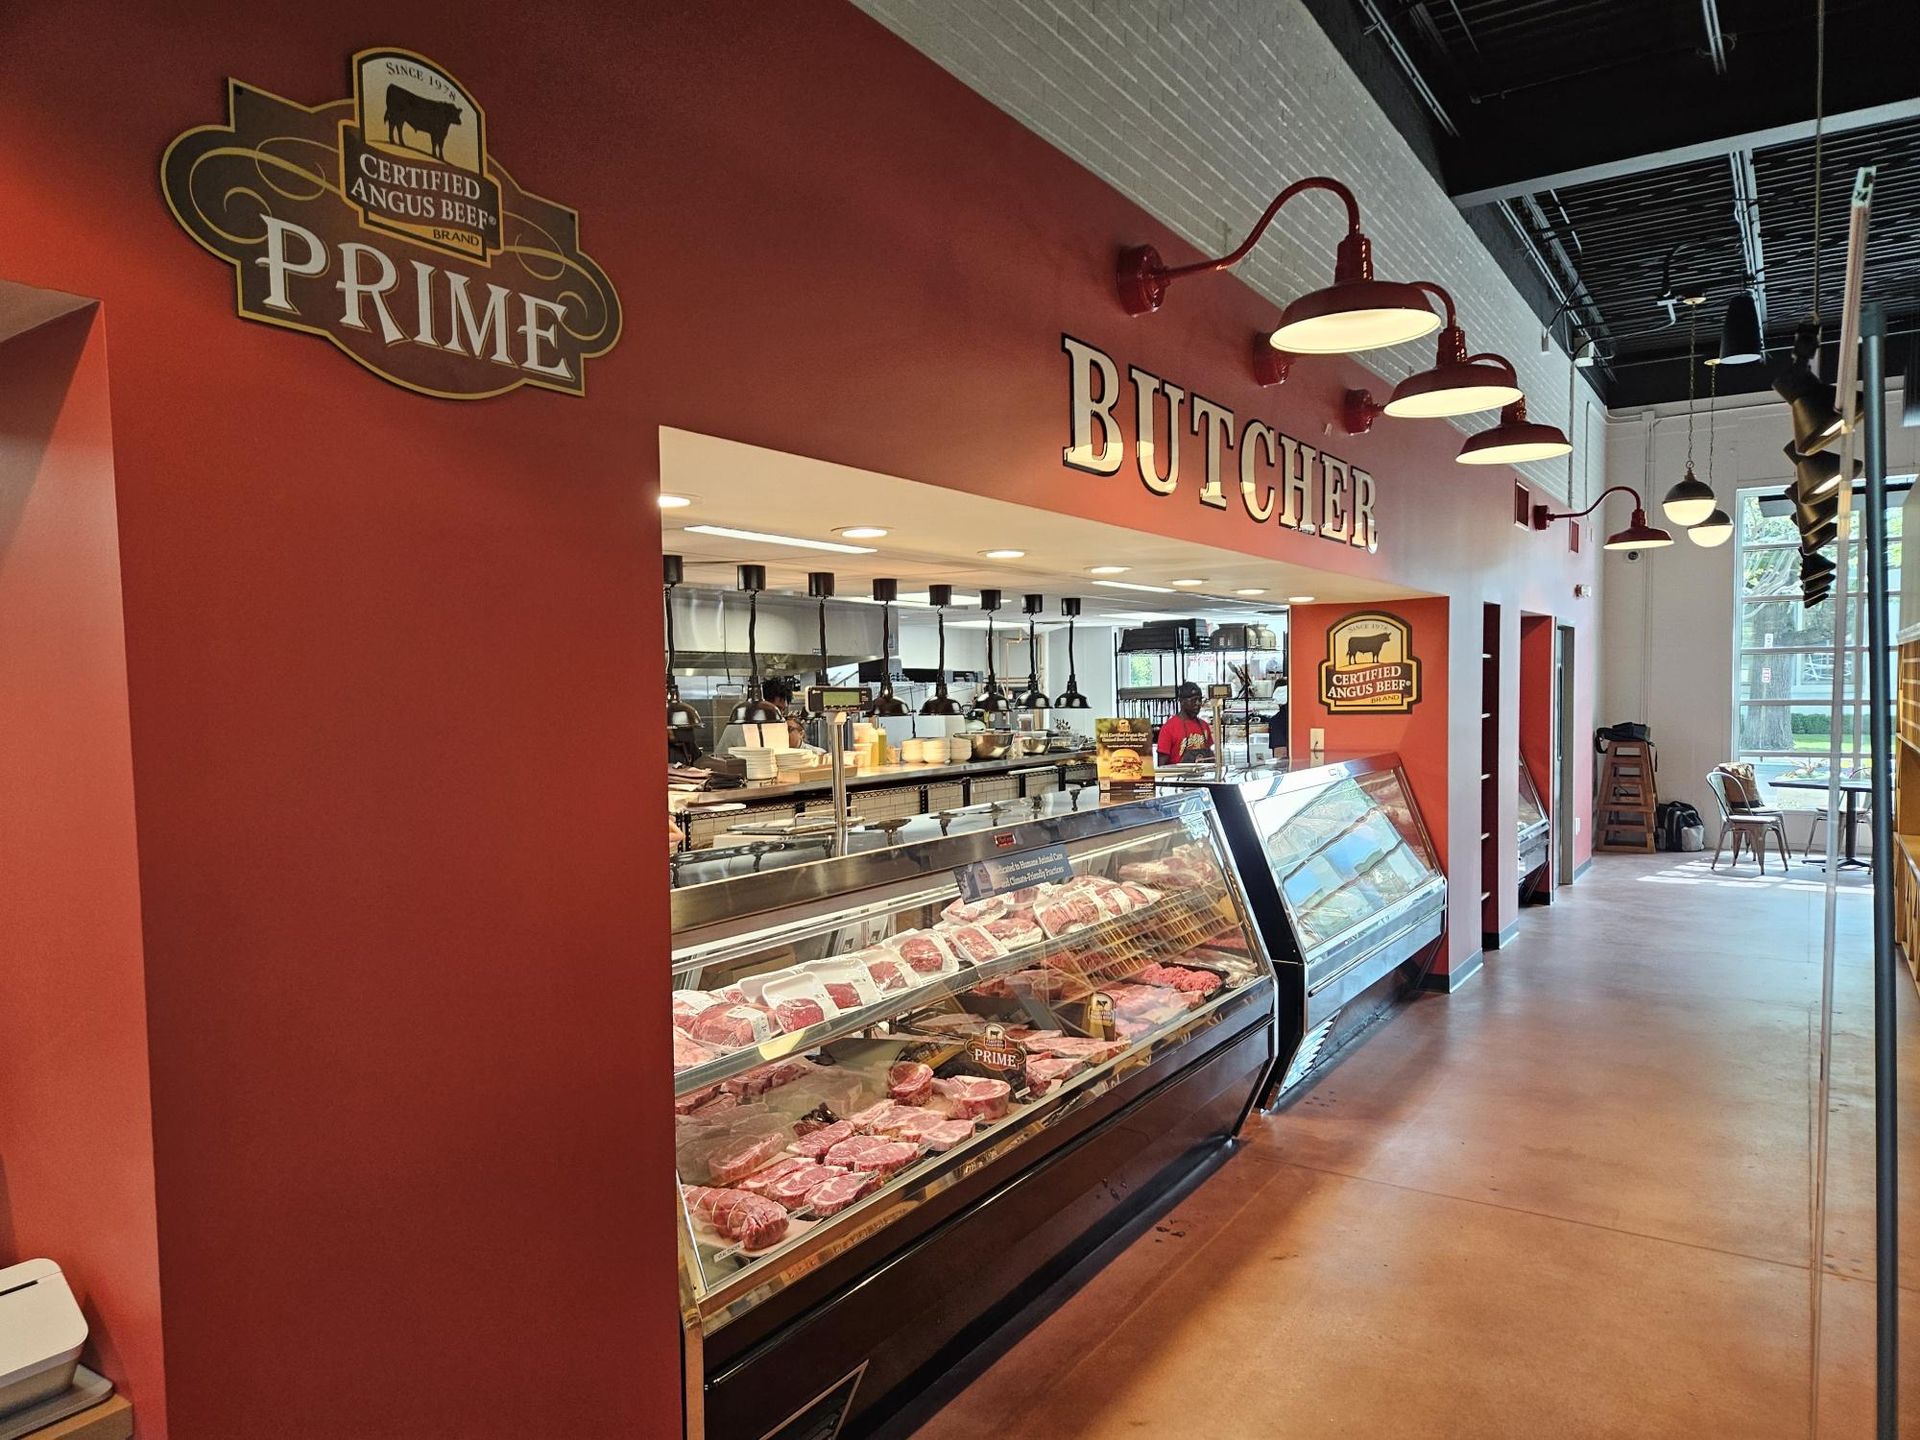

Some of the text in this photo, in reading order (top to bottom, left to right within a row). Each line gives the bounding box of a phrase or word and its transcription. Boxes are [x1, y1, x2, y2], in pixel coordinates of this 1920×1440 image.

[385, 61, 457, 102] SINCE 1978
[359, 153, 480, 201] CERTIFIED
[350, 177, 436, 219] ANGUS
[432, 228, 480, 247] BRAND
[255, 213, 576, 382] PRIME
[1061, 332, 1379, 554] BUTCHER
[1327, 684, 1373, 698] ANGUS
[1332, 666, 1401, 686] CERTIFIED
[1371, 694, 1400, 704] BRAND
[974, 1048, 1016, 1067] PRIME
